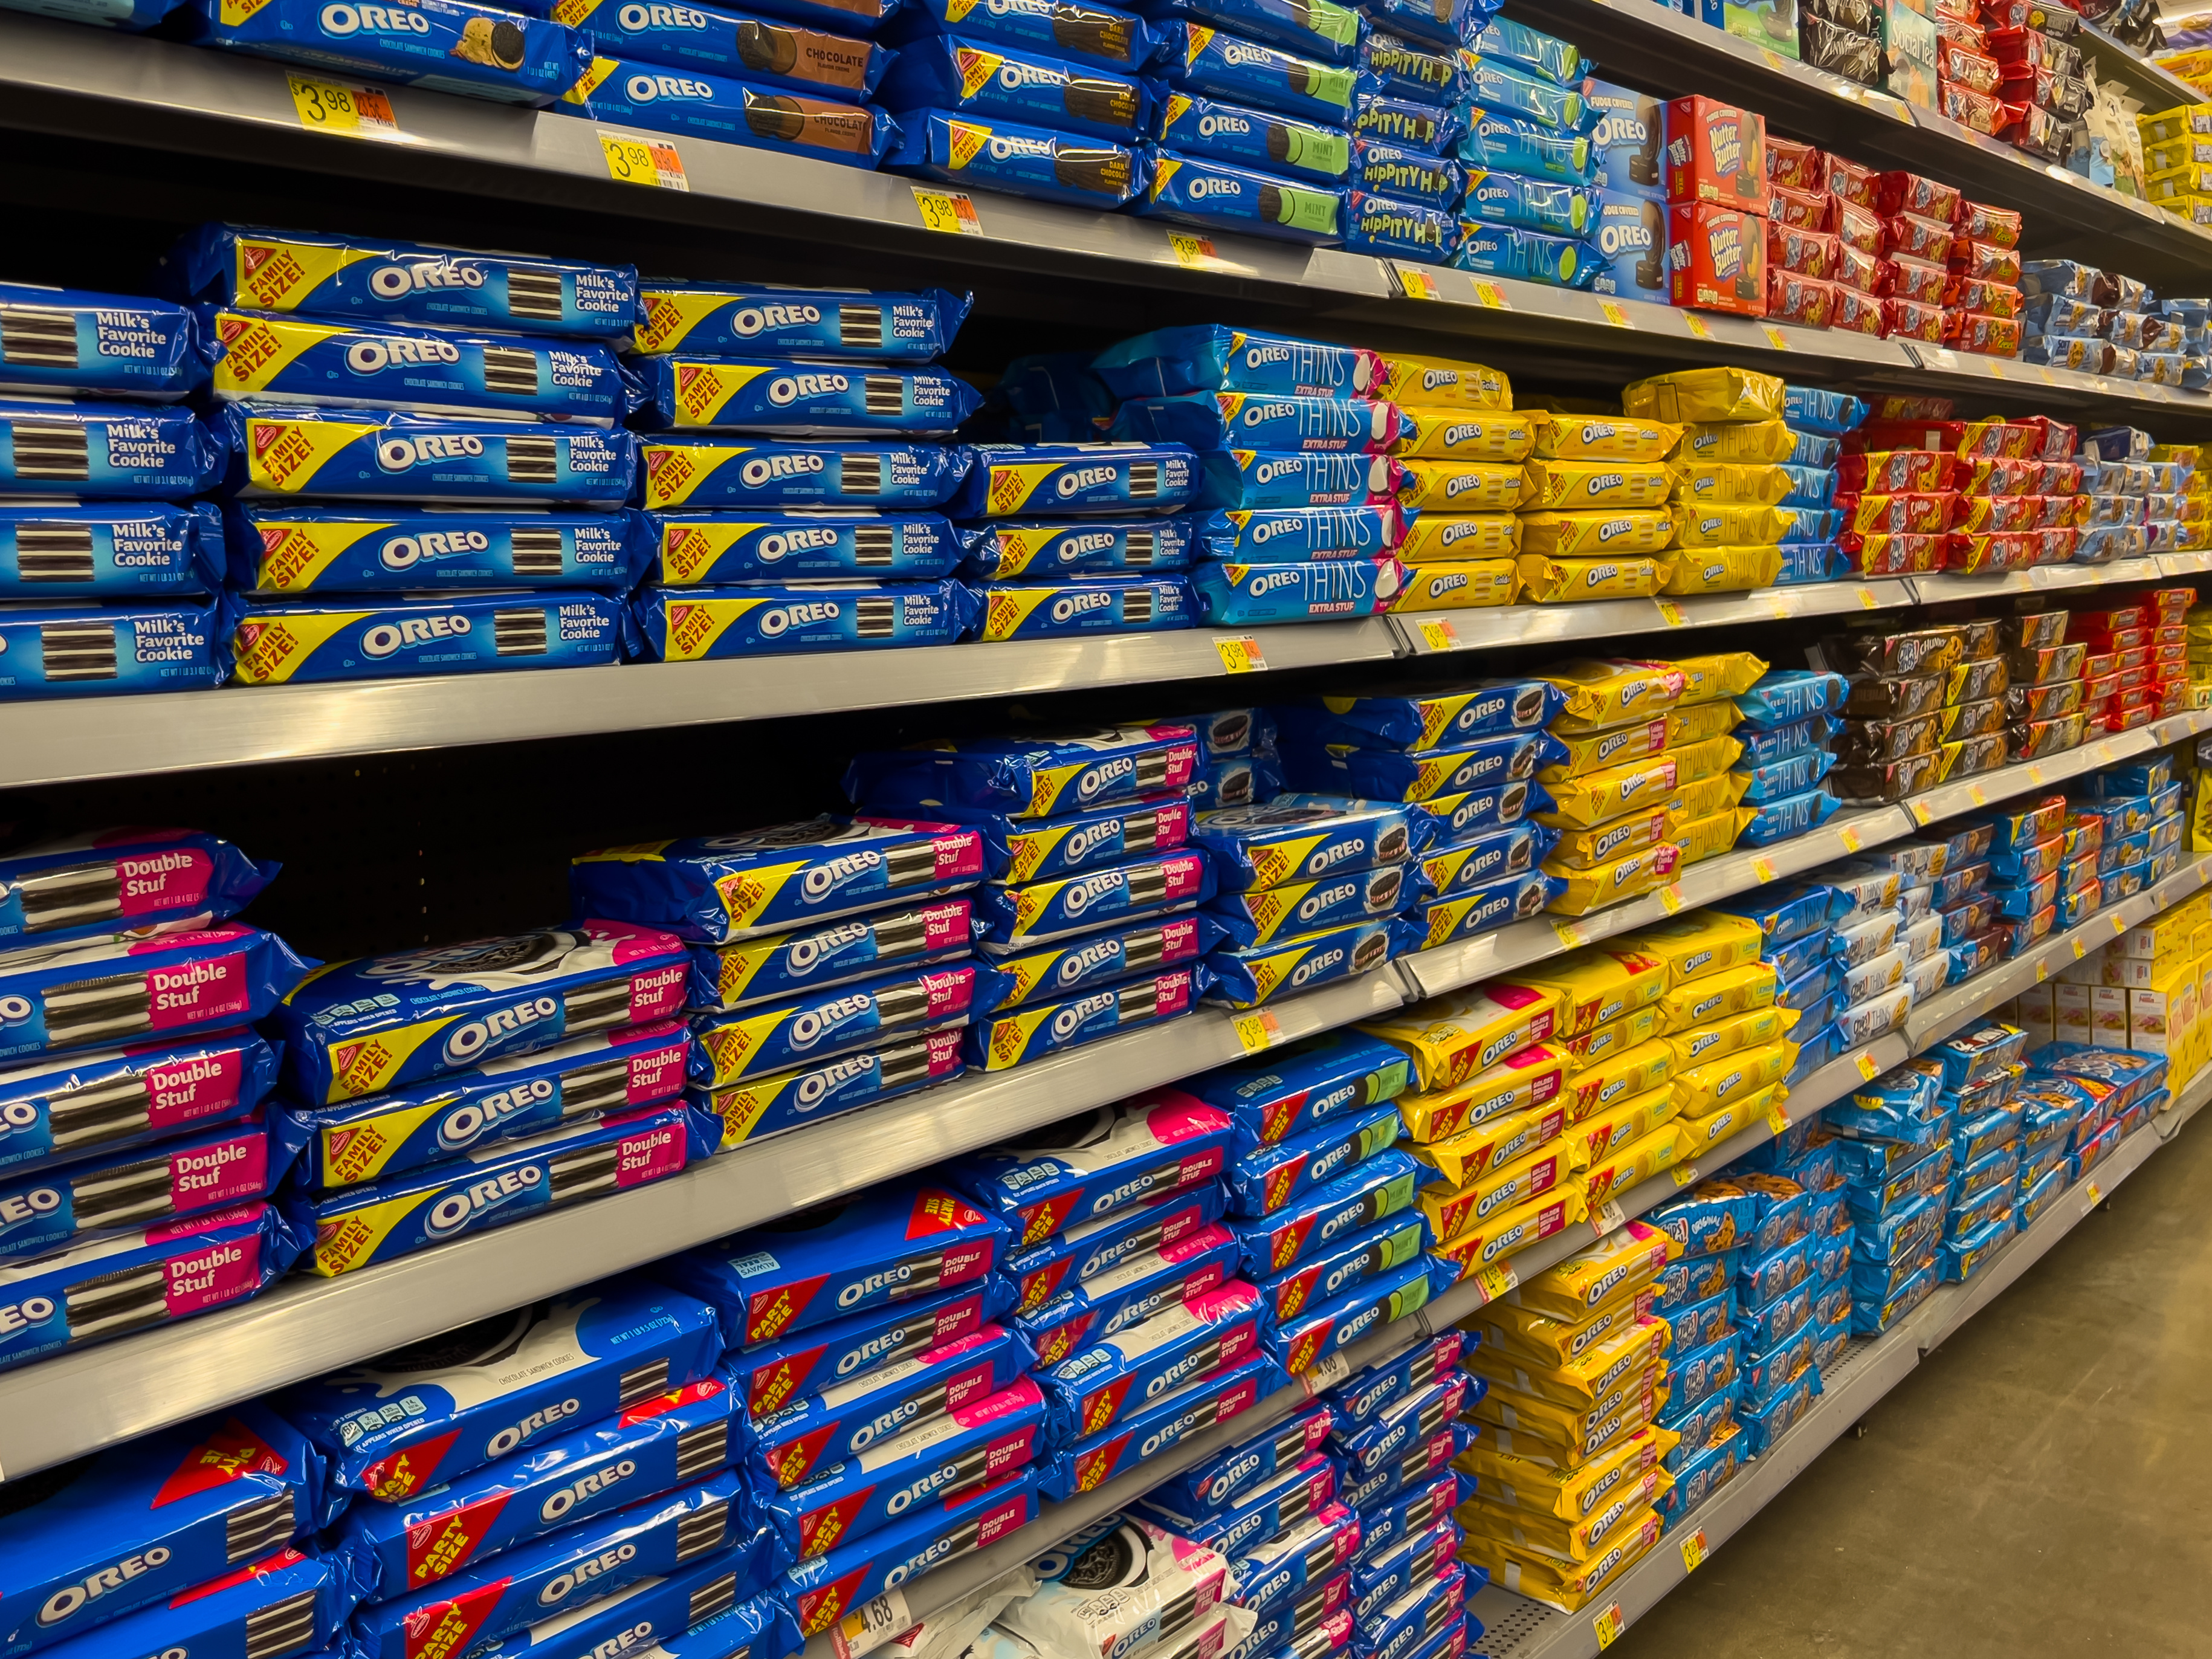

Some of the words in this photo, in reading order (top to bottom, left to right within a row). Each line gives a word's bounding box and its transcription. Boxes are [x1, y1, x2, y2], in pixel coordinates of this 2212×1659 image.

[322, 4, 430, 34] OREO
[619, 4, 707, 31] OREO
[380, 39, 403, 50] CHOCOLATE
[404, 42, 426, 53] SANDWICH
[427, 47, 445, 58] COOKIES
[806, 47, 863, 68] CHOCOLATE
[1892, 22, 1921, 61] Social
[1920, 34, 1935, 69] Tea
[1371, 50, 1421, 75] HIPPITY
[627, 75, 713, 102] OREO
[1591, 97, 1610, 108] FUDGE
[1313, 141, 1333, 157] MINT
[1710, 124, 1738, 152] Nutter
[1714, 141, 1741, 173] Butter
[1364, 164, 1420, 187] HIPPITY
[1305, 202, 1327, 216] MINT
[1361, 215, 1413, 238] HIPPITY
[1710, 228, 1738, 256] Nutter
[1467, 241, 1498, 254] OREO
[1504, 233, 1554, 276] THINS
[1714, 246, 1742, 278] Butter
[248, 249, 294, 297] FAMILY
[372, 265, 484, 299] OREO
[575, 274, 615, 288] Milk's
[259, 262, 306, 309] SIZE!
[575, 287, 629, 302] Favorite
[575, 300, 619, 314] Cookie
[892, 306, 923, 317] Milk's
[97, 312, 149, 329] Milk's
[732, 305, 820, 335] OREO
[892, 317, 934, 329] Favorite
[98, 327, 166, 344] Favorite
[892, 327, 925, 338] Cookie
[99, 343, 155, 358] Cookie
[769, 374, 849, 405] OREO
[913, 386, 951, 396] Favorite
[913, 395, 944, 407] Cookie
[1295, 385, 1315, 396] EXTRA
[1316, 386, 1334, 397] STUF
[108, 439, 176, 454] Favorite
[379, 436, 483, 471] OREO
[569, 448, 616, 461] Favorite
[1302, 439, 1325, 450] EXTRA
[1326, 439, 1348, 450] STUF
[109, 453, 165, 468] Cookie
[570, 460, 609, 473] Cookie
[743, 454, 824, 485] OREO
[1310, 493, 1331, 503] EXTRA
[1331, 493, 1350, 503] STUF
[383, 532, 488, 567] OREO
[1249, 572, 1300, 597] OREO
[1298, 561, 1366, 601] THINS
[560, 604, 595, 617] Milk's
[1309, 603, 1333, 613] EXTRA
[1334, 601, 1354, 612] STUF
[135, 620, 185, 634] Milk's
[560, 616, 609, 629] Favorite
[760, 602, 840, 637] OREO
[136, 633, 204, 648] Favorite
[364, 615, 471, 656] OREO
[560, 627, 600, 640] Cookie
[136, 647, 193, 663] Cookie
[1919, 638, 1947, 656] CHUNKY
[1169, 748, 1192, 762] Double
[122, 853, 193, 878] Double
[938, 850, 960, 865] Stuf
[125, 873, 167, 897] Stuf
[928, 920, 951, 935] Stuf
[153, 964, 227, 993] Double
[635, 969, 683, 993] Double
[1157, 975, 1188, 991] Double
[156, 986, 201, 1011] Stuf
[410, 994, 436, 1005] CHOCOLATE
[436, 989, 462, 1000] SANDWICH
[462, 985, 487, 996] COOKIES
[635, 989, 664, 1007] Stuf
[1158, 988, 1176, 1003] Stuf
[449, 998, 557, 1059] OREO
[632, 1049, 682, 1073] Double
[151, 1061, 222, 1090] Double
[632, 1068, 663, 1088] Stuf
[155, 1084, 196, 1110] Stuf
[441, 1080, 554, 1150] OREO
[334, 1124, 377, 1177] FAMILY
[622, 1131, 671, 1155] Double
[176, 1144, 247, 1174] Double
[344, 1132, 388, 1183] SIZE!
[622, 1151, 652, 1171] Stuf
[1182, 1158, 1212, 1176] DOUBLE
[178, 1168, 221, 1192] Stuf
[1182, 1168, 1201, 1183] STUF
[428, 1165, 543, 1235] OREO
[170, 1224, 183, 1235] NET
[183, 1221, 195, 1231] WT
[202, 1217, 211, 1226] LB
[1692, 1215, 1722, 1235] ORIGINAL
[319, 1215, 363, 1264] FAMILY
[331, 1223, 375, 1274] SIZE!
[1274, 1226, 1298, 1269] PARTY
[170, 1247, 242, 1278] Double
[944, 1263, 966, 1277] STUF
[945, 1252, 981, 1268] DOUBLE
[173, 1269, 216, 1297] Stuf
[838, 1267, 912, 1309] OREO
[751, 1290, 791, 1340] PARTY
[765, 1305, 794, 1338] SIZE
[937, 1320, 960, 1334] STUF
[938, 1308, 972, 1326] DOUBLE
[1336, 1306, 1380, 1345] OREO
[610, 1335, 621, 1345] NET
[621, 1331, 630, 1341] WT
[635, 1327, 642, 1336] LB
[641, 1324, 650, 1334] 9.5
[650, 1321, 658, 1331] OZ
[1221, 1331, 1249, 1350] DOUBLE
[836, 1329, 905, 1376] OREO
[1221, 1343, 1238, 1358] STUF
[1289, 1333, 1315, 1374] PARTY
[498, 1368, 526, 1386] CHOCOLATE
[526, 1360, 552, 1377] SANDWICH
[552, 1352, 575, 1368] COOKIES
[486, 1398, 580, 1459] OREO
[850, 1400, 918, 1452] OREO
[988, 1453, 1011, 1469] STUF
[989, 1439, 1024, 1460] DOUBLE
[542, 1460, 636, 1523] OREO
[887, 1466, 956, 1515] OREO
[804, 1507, 838, 1557] PARTY
[982, 1509, 1015, 1531] DOUBLE
[981, 1524, 1002, 1541] STUF
[414, 1515, 465, 1578] PARTY
[434, 1534, 469, 1575] SIZE
[36, 1546, 170, 1626] OREO
[539, 1544, 636, 1606] OREO
